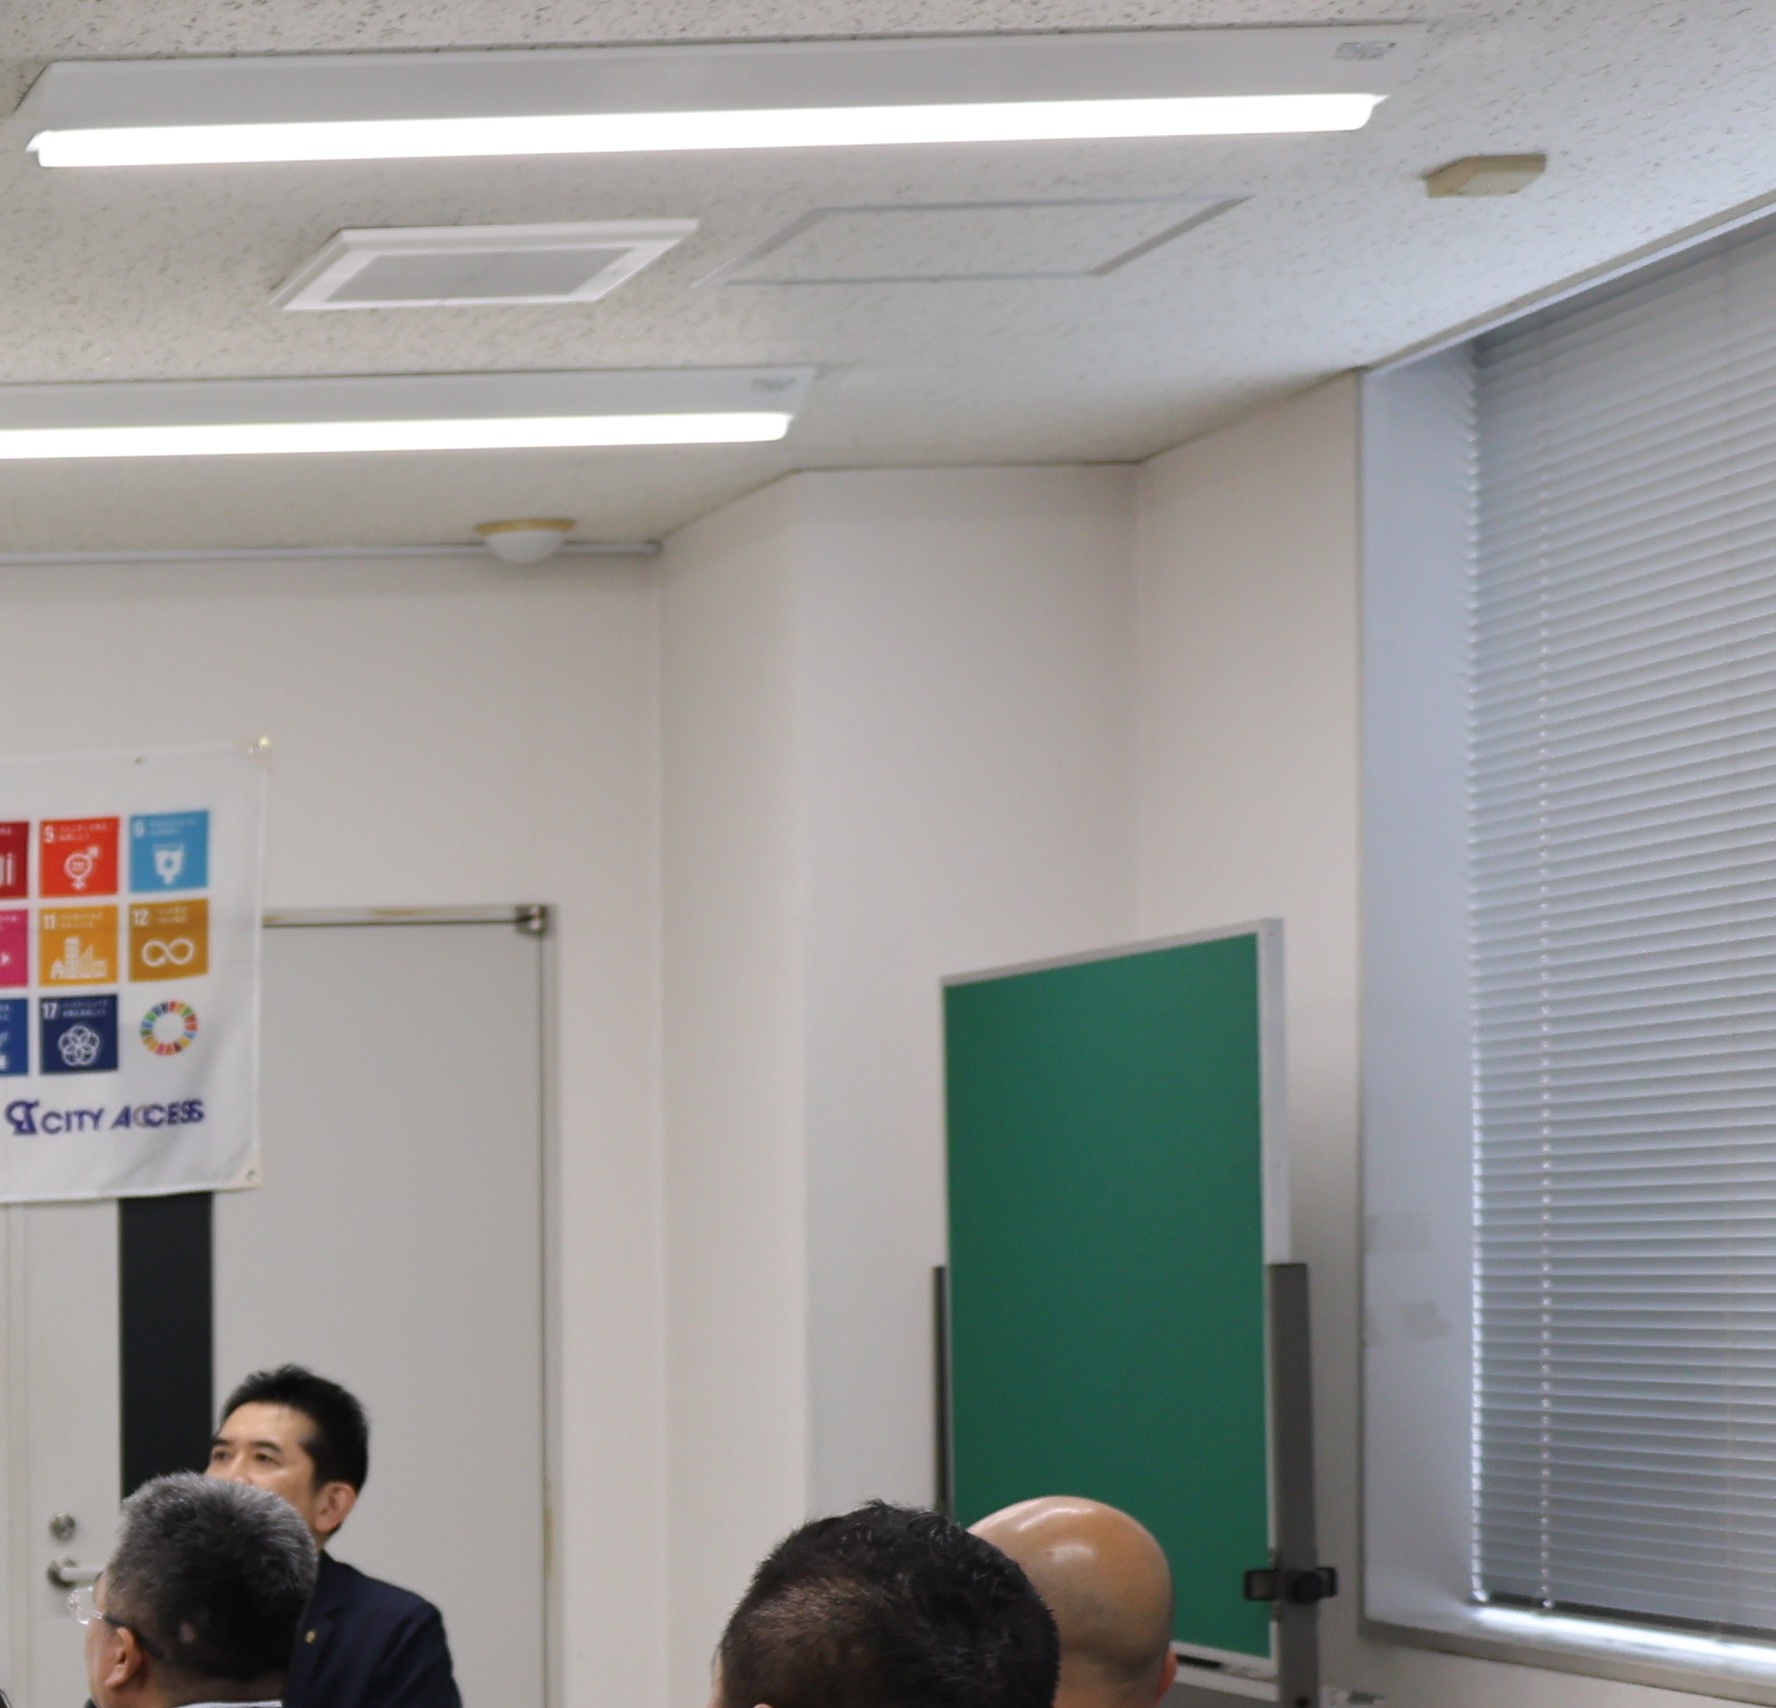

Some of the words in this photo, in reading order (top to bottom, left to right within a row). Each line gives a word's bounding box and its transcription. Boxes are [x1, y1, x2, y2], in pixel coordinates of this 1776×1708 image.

[44, 826, 55, 843] 5
[134, 820, 145, 837] 6
[44, 914, 57, 930] 11
[133, 910, 149, 926] 12
[42, 1003, 60, 1019] 17
[40, 1107, 105, 1135] CITY
[110, 1099, 206, 1130] ACCESS
